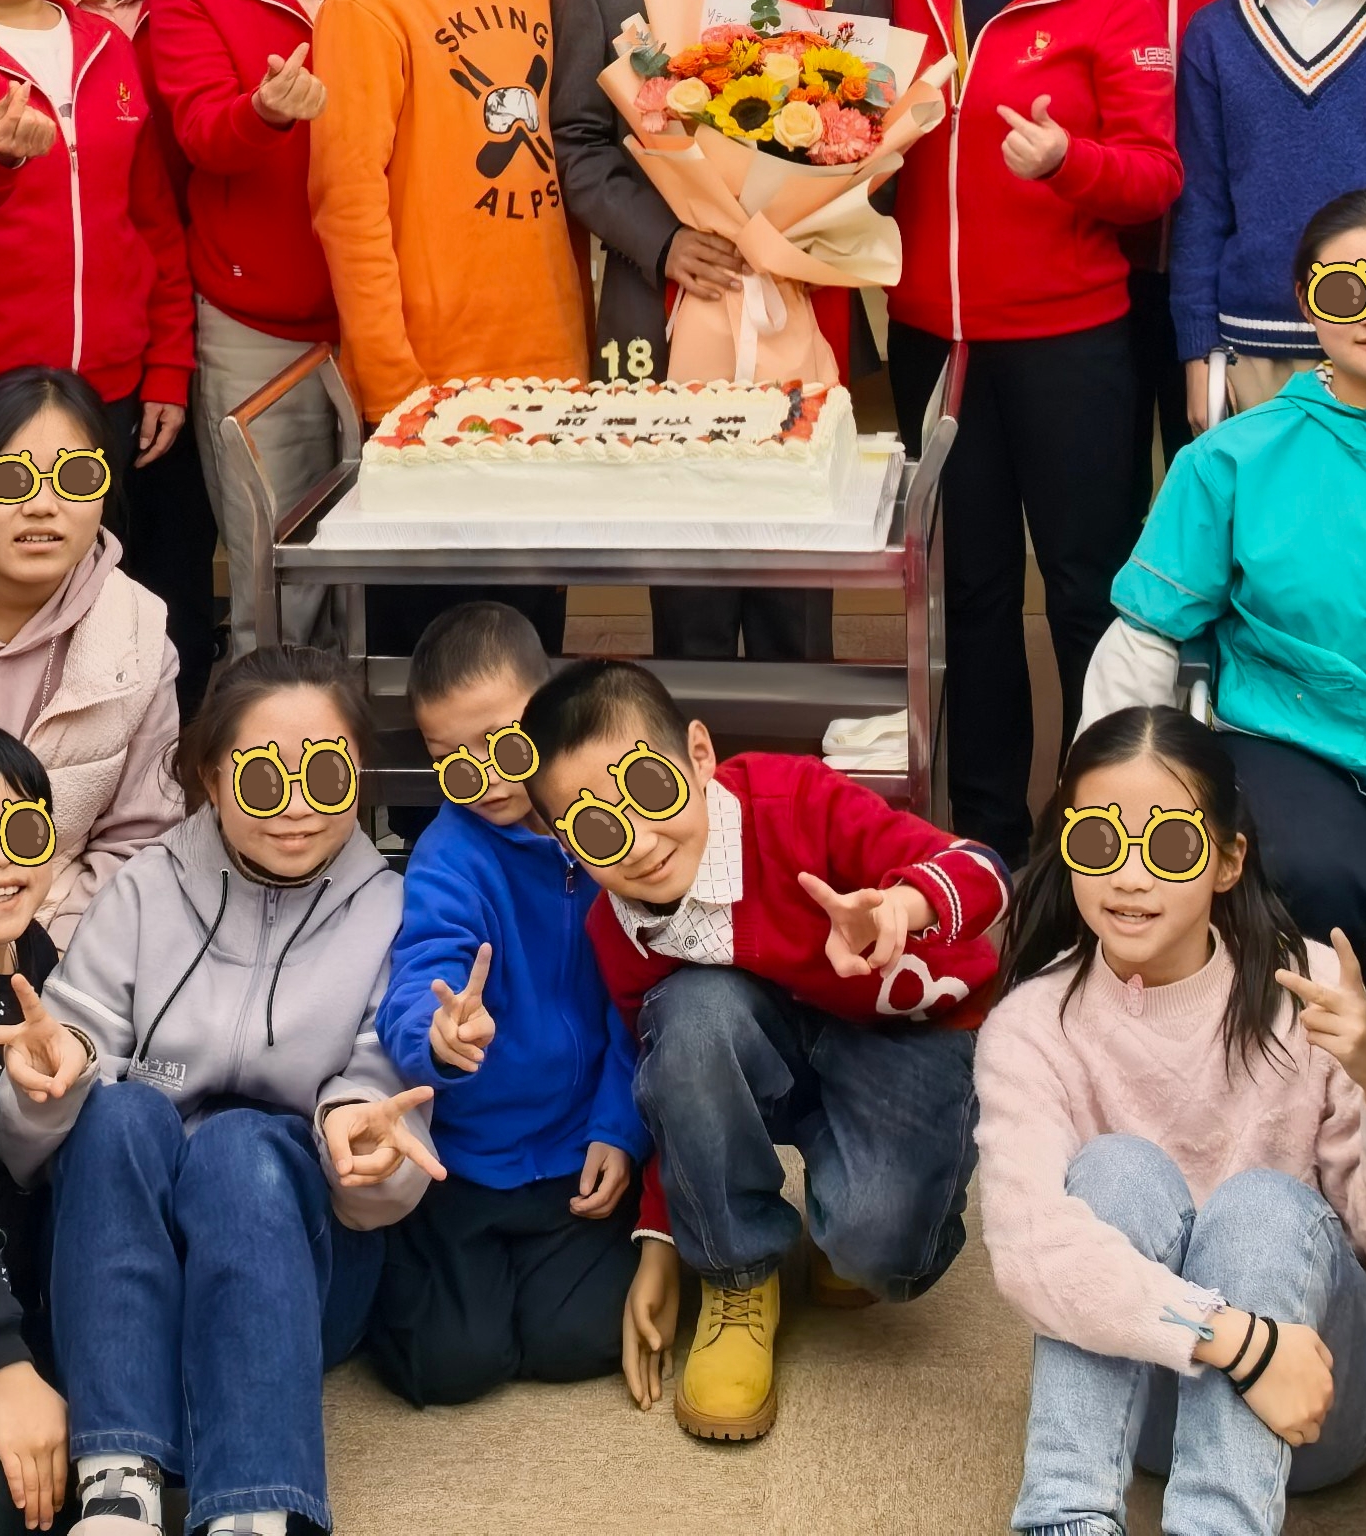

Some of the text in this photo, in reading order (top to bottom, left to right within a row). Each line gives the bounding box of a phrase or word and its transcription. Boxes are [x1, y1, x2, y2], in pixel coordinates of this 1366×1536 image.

[434, 4, 549, 54] SKIING
[473, 179, 561, 220] ALPS
[601, 337, 655, 379] 18
